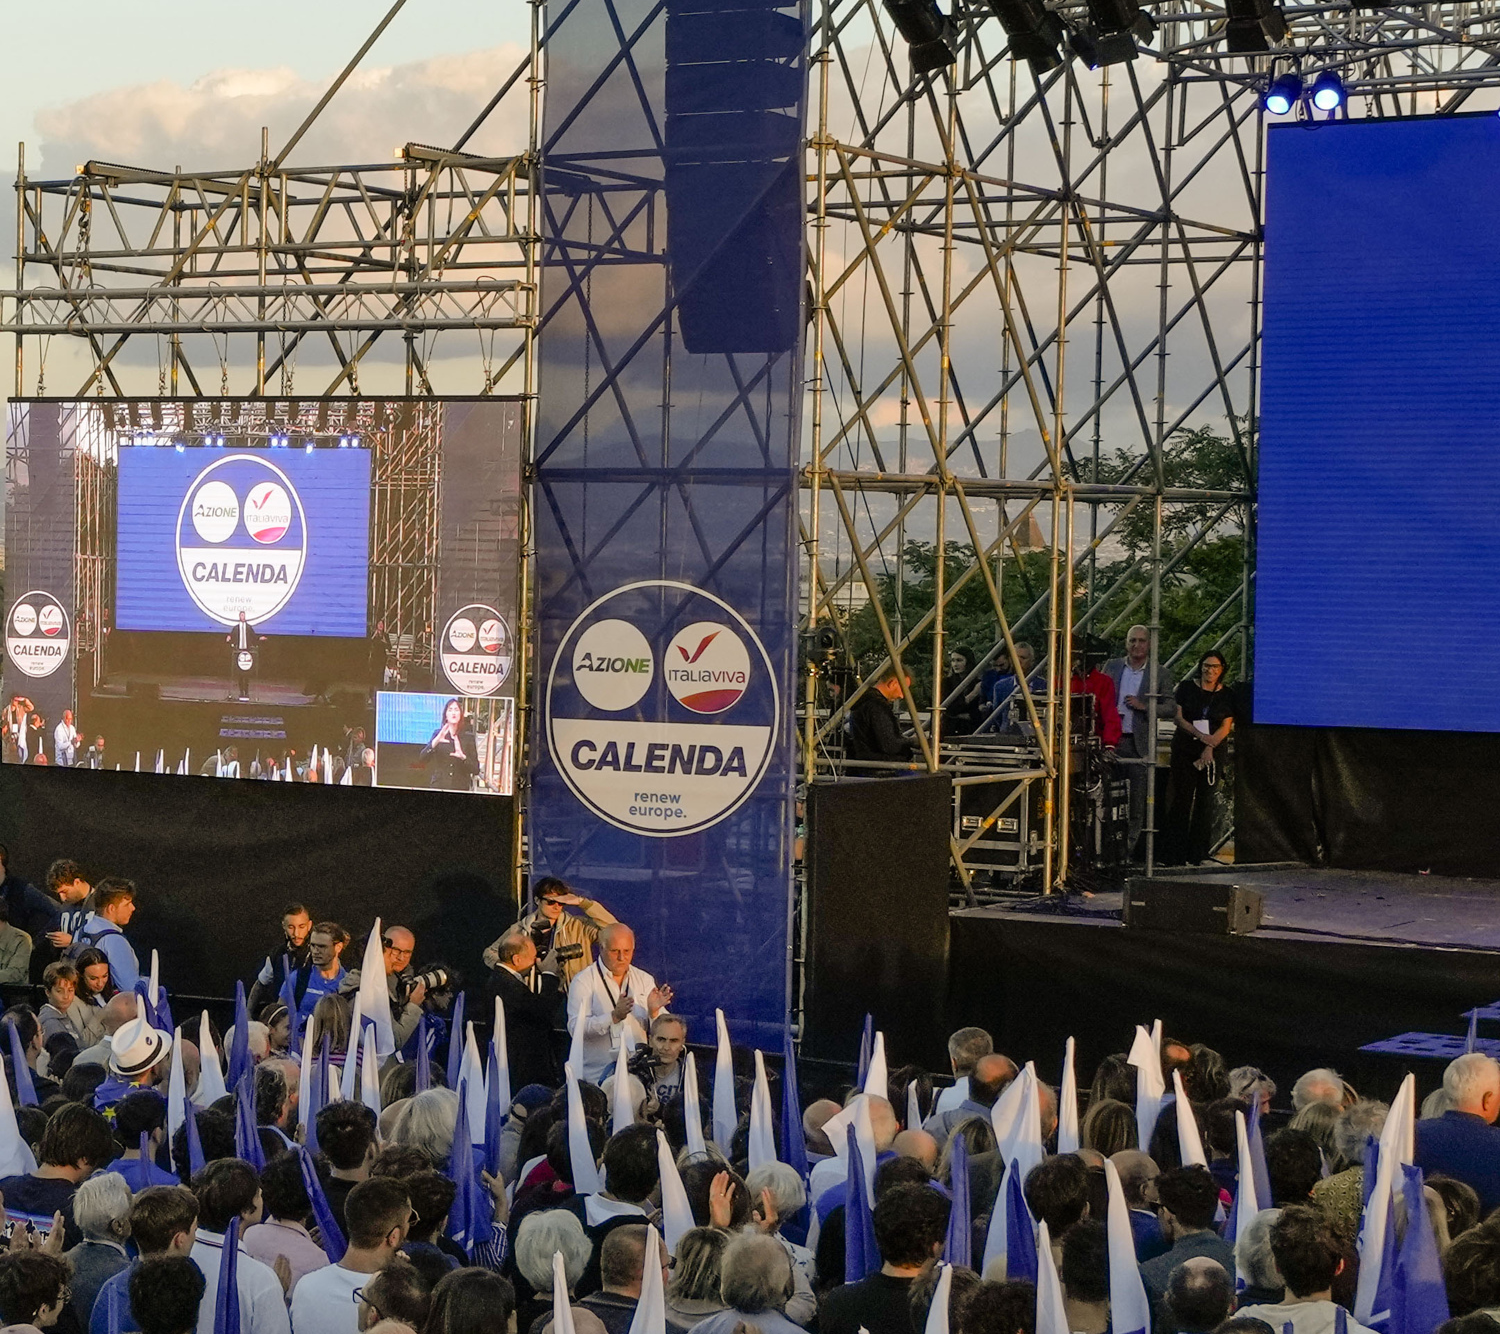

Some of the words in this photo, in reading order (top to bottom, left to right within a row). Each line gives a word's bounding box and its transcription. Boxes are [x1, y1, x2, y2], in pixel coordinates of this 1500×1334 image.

[192, 561, 288, 584] CALENDA
[13, 644, 62, 656] CALENDA
[449, 661, 504, 675] CALENDA
[576, 652, 651, 674] AZIONE
[570, 739, 748, 778] CALENDA
[634, 792, 682, 804] renew
[628, 804, 687, 821] europe.
